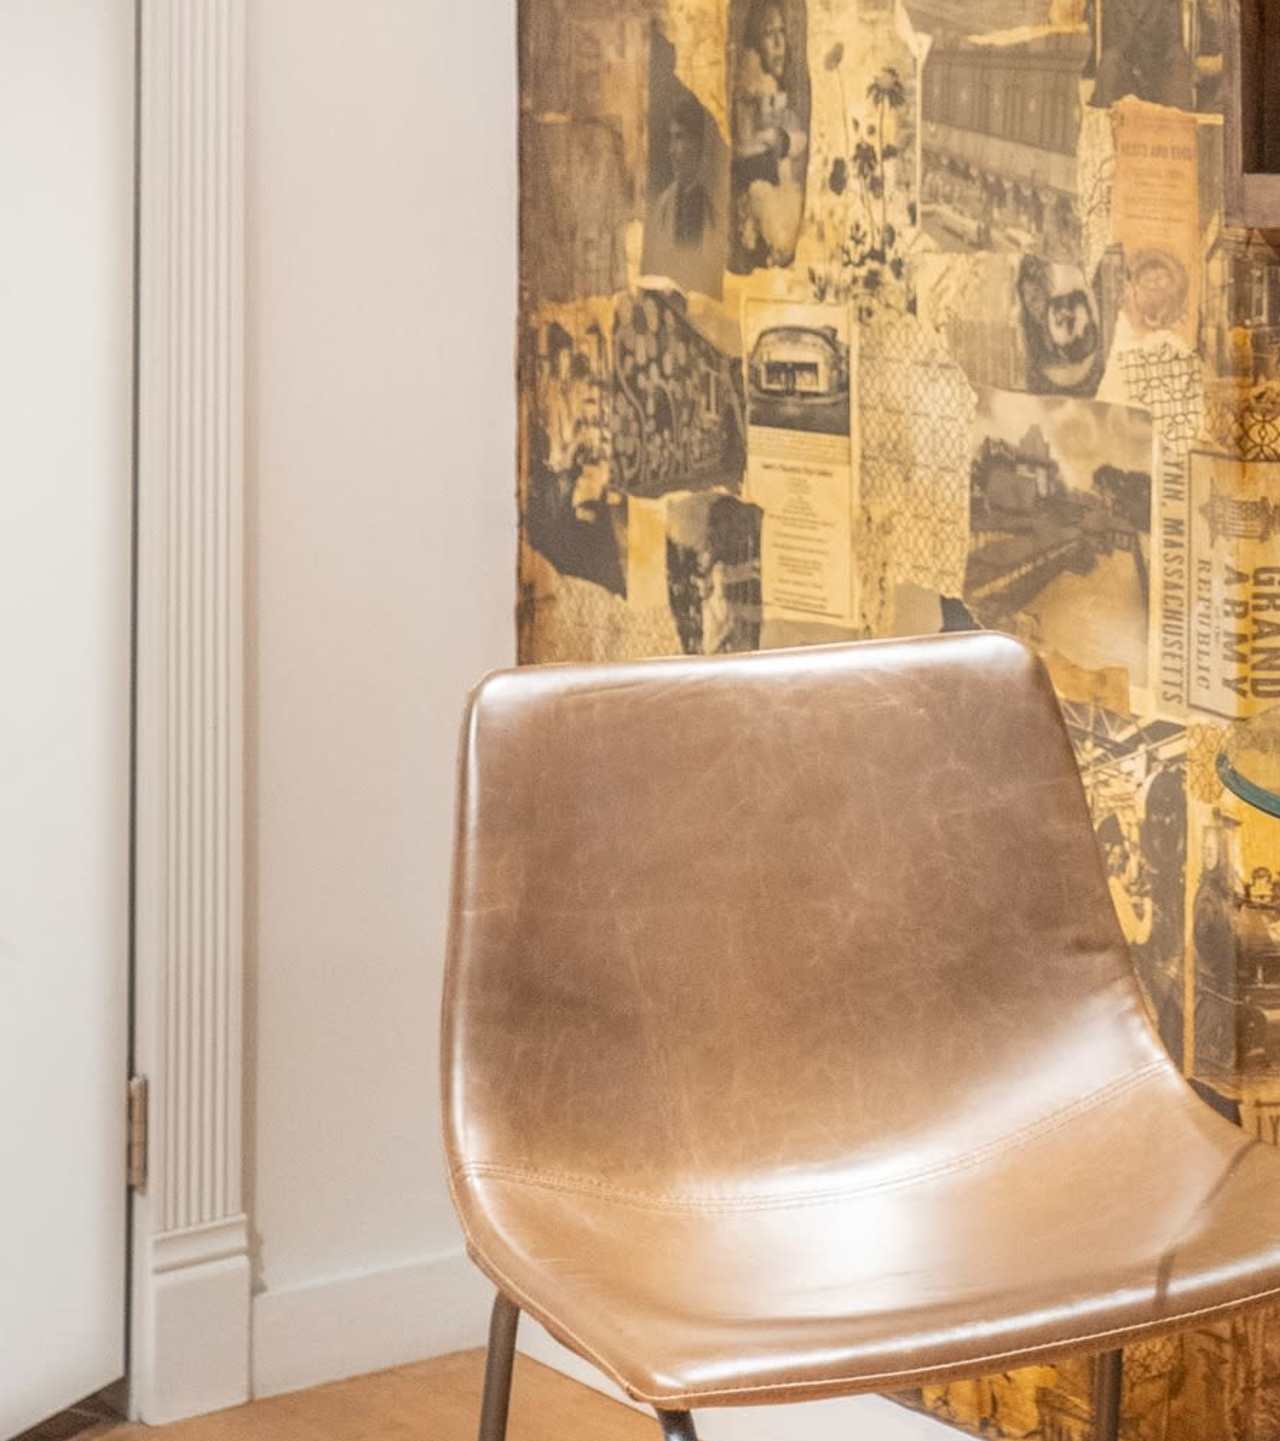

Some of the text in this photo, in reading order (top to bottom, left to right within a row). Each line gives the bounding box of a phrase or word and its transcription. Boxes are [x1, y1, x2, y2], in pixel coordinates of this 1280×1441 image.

[1160, 448, 1187, 706] YNN, MASSACHUSETTS
[1196, 557, 1213, 691] REPUBLIC
[1221, 562, 1251, 700] ARMY
